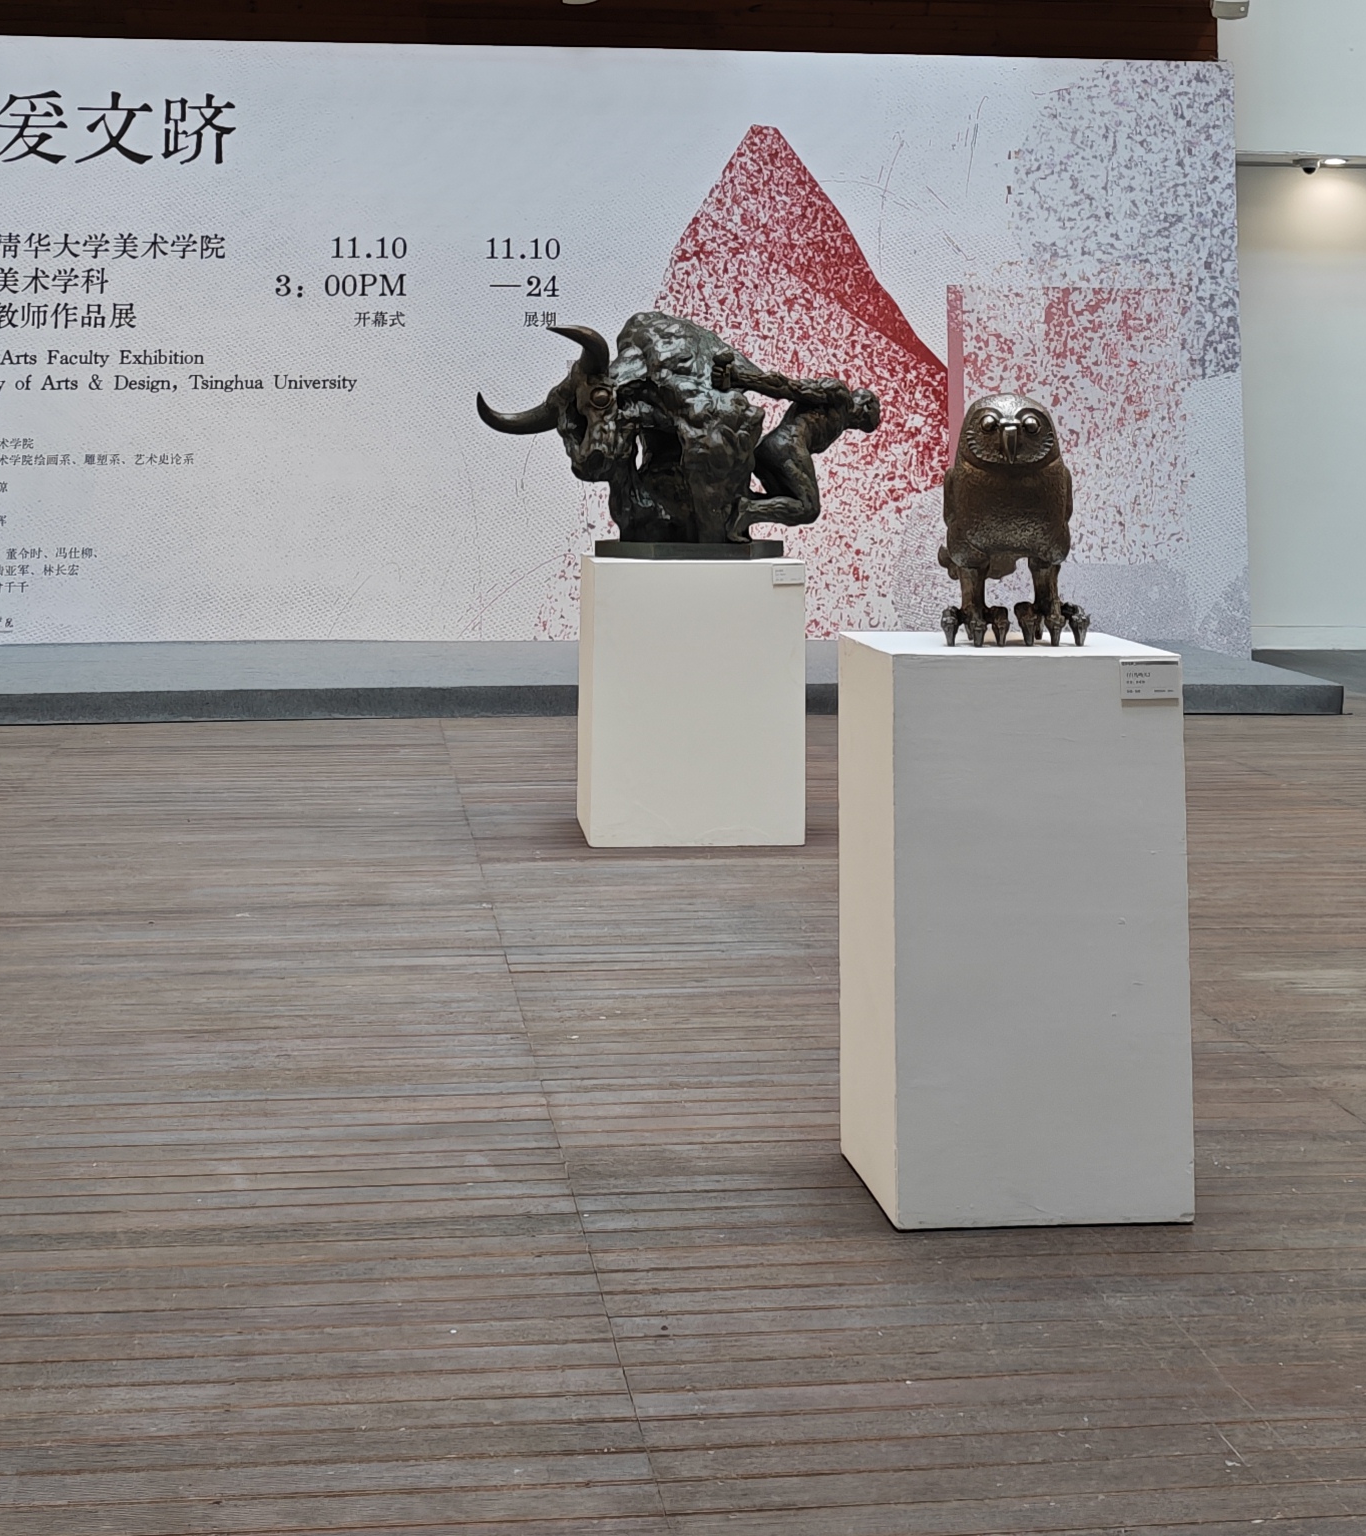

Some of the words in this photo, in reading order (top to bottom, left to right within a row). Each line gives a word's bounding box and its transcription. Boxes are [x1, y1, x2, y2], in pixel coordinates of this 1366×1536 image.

[331, 236, 408, 260] 11.10
[485, 237, 561, 260] 11.10
[353, 310, 406, 328] 开幕式
[523, 311, 558, 328] 展期
[0, 349, 38, 365] Arts
[46, 349, 110, 368] Faculty
[118, 349, 205, 365] Exhibition
[14, 375, 33, 391] of
[40, 375, 79, 391] Arts
[87, 374, 104, 391] &
[113, 375, 178, 393] Design,
[188, 374, 264, 393] Tsinghua
[273, 374, 358, 393] University
